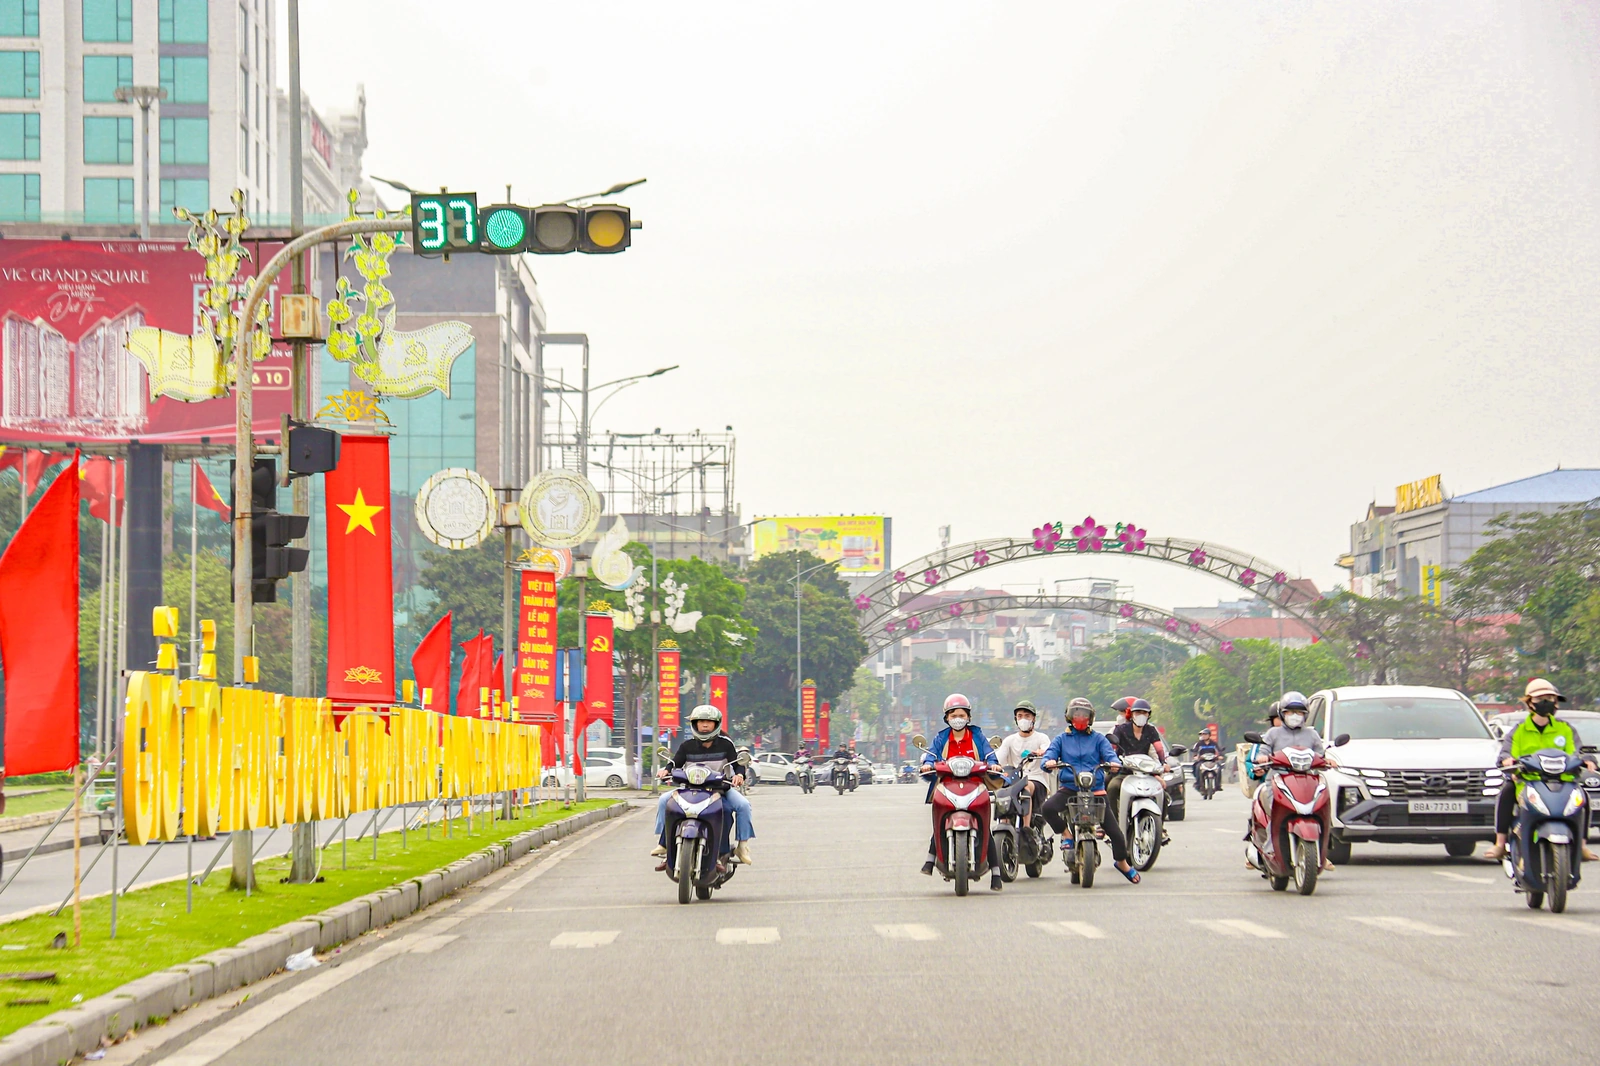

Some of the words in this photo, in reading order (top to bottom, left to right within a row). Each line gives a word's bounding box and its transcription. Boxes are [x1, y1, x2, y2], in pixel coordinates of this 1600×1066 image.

[419, 200, 475, 248] 37
[2, 267, 28, 281] VIC
[30, 268, 88, 282] GRAND
[90, 269, 150, 286] SQUARE
[266, 372, 283, 385] 10
[527, 579, 543, 593] VIỆT
[523, 594, 543, 607] THÀNH
[537, 610, 550, 625] HỘI
[520, 641, 531, 655] CỘI
[522, 656, 536, 669] DÂN
[536, 657, 549, 672] TỘC
[520, 672, 534, 686] VIỆT
[534, 674, 550, 685] NAM
